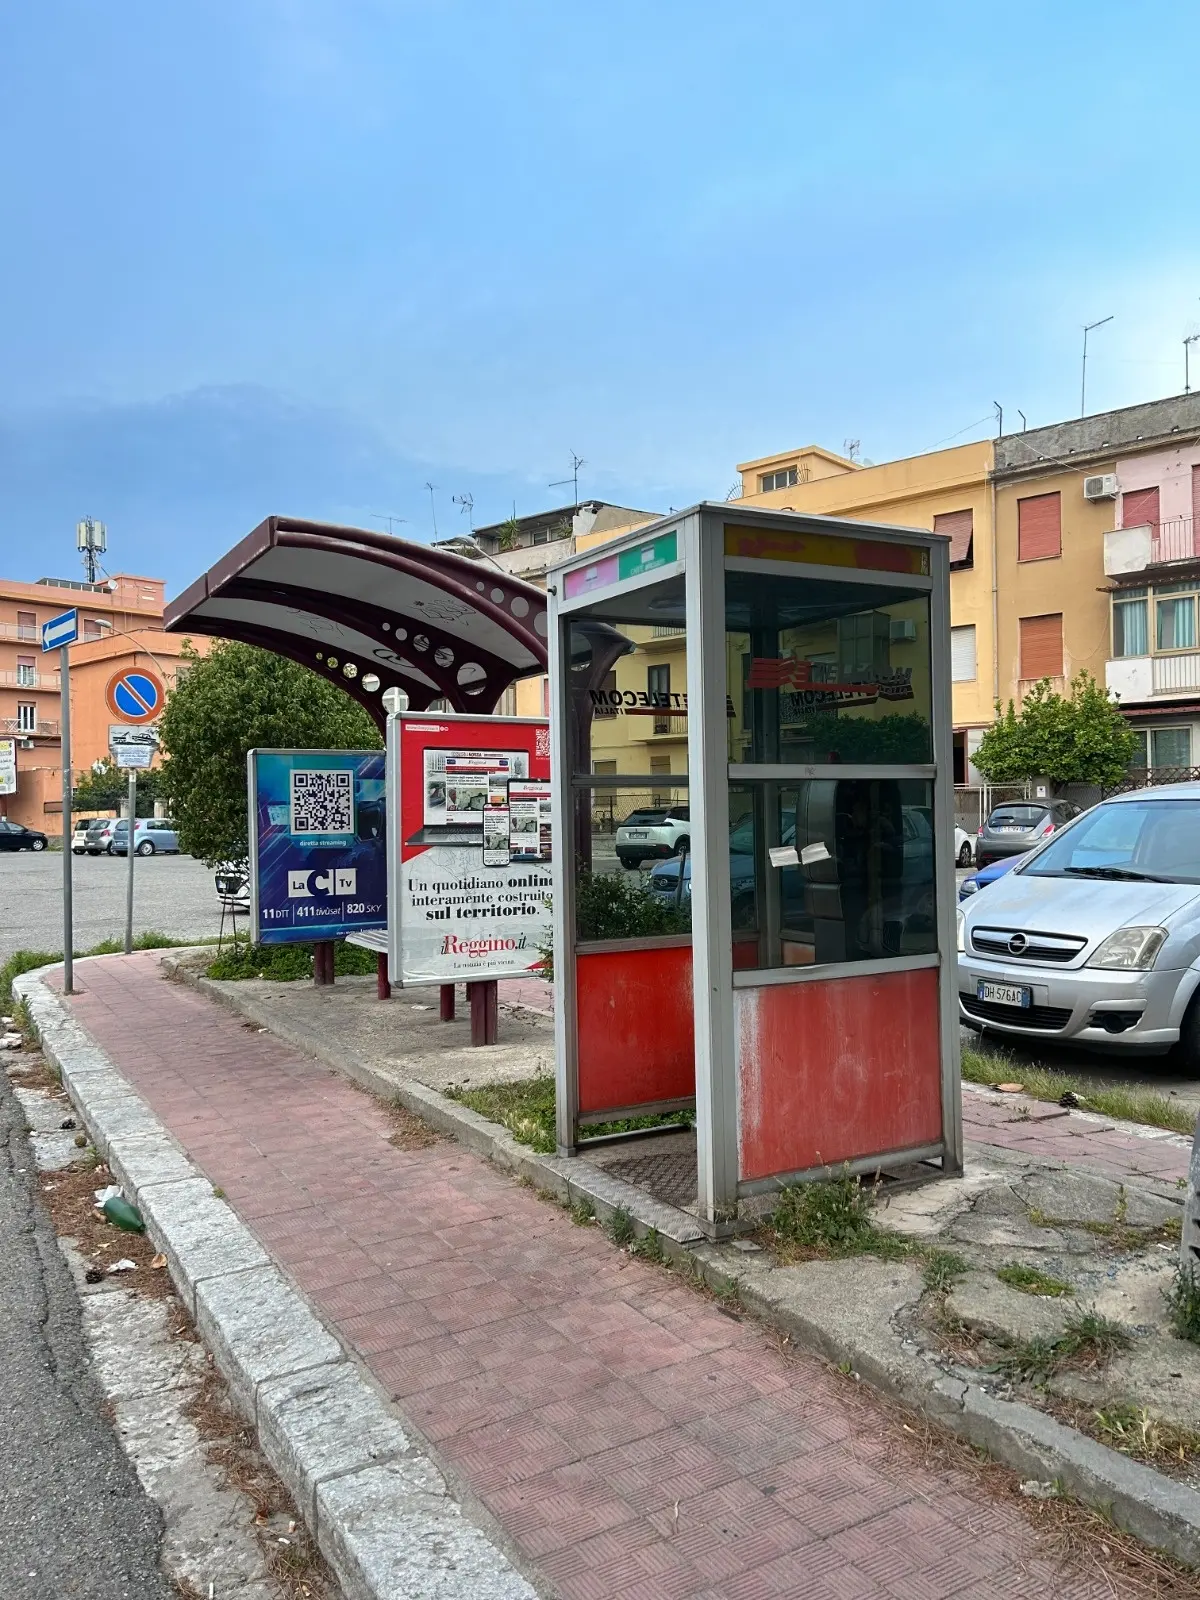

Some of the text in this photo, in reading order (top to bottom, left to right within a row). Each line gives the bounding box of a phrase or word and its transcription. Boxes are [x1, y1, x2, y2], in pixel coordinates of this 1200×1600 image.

[320, 839, 346, 847] streaming
[408, 878, 427, 892] Un
[432, 876, 503, 894] quotidiano
[412, 889, 553, 907] interamente costruito
[346, 903, 365, 914] 820
[366, 904, 382, 913] SKY
[426, 902, 540, 921] sul territorio.
[984, 986, 1022, 1003] DH 576AC
